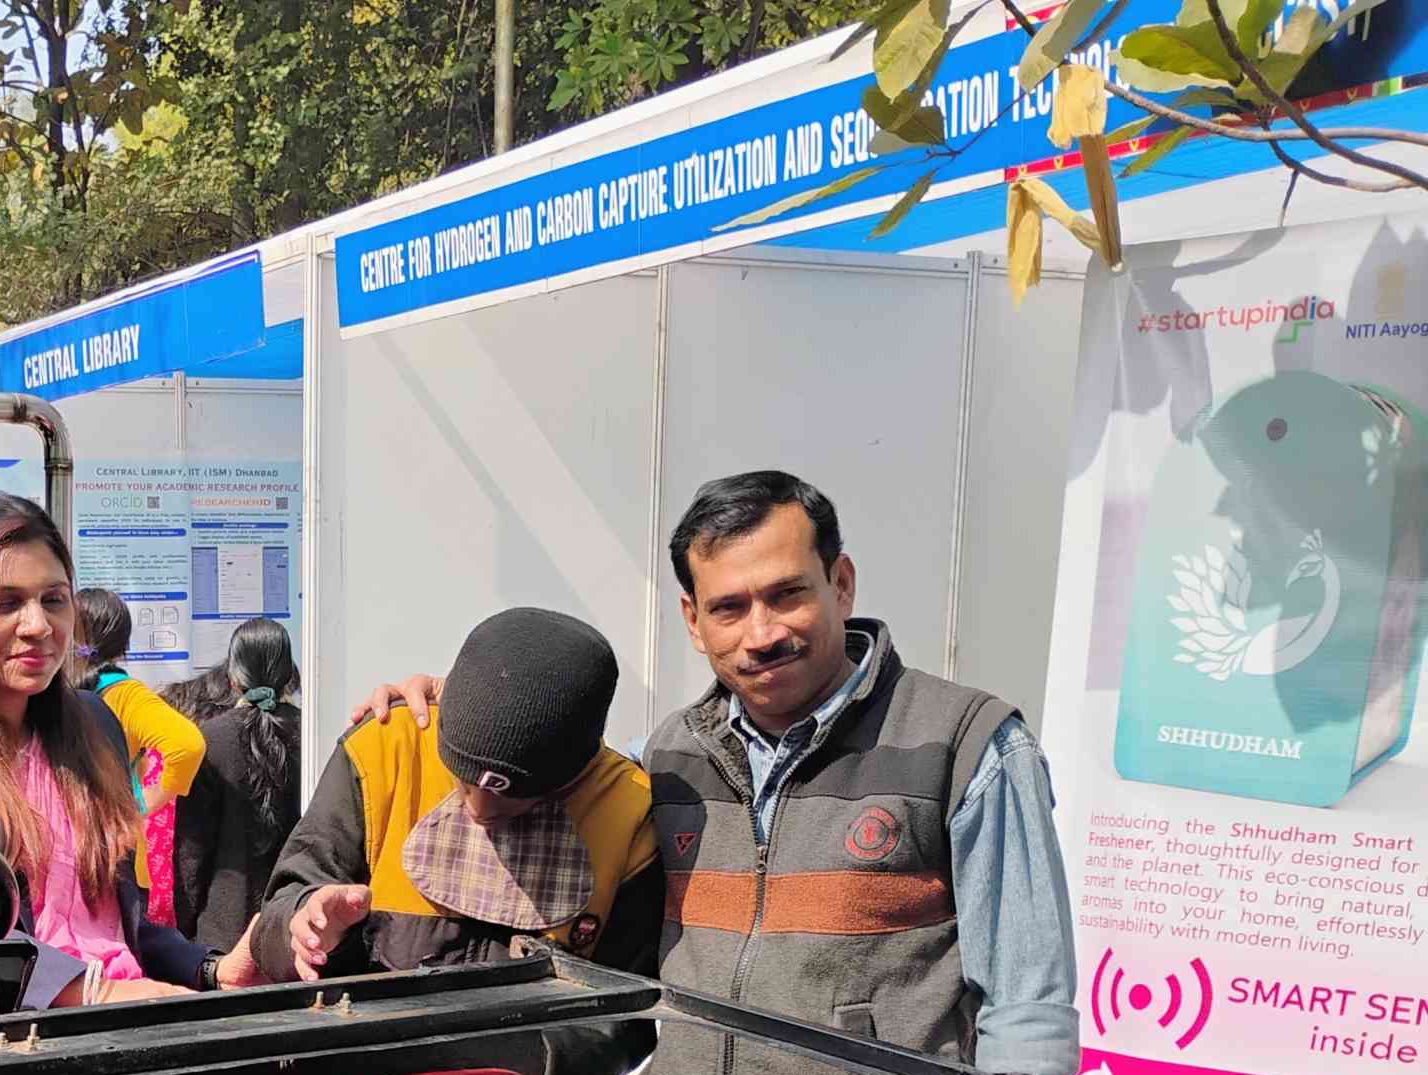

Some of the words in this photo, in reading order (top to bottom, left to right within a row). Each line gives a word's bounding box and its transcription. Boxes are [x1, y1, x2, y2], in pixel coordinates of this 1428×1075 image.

[360, 244, 405, 293] CENTRE
[408, 236, 432, 280] FOR
[435, 215, 501, 273] HYDROGEN
[505, 206, 532, 255] AND
[537, 187, 594, 246] CARBON
[598, 166, 668, 230] CAPTURE
[673, 134, 777, 209] UTILIZATION
[783, 121, 822, 181] AND
[1137, 296, 1334, 334] #startupindia
[1346, 322, 1376, 340] NITI
[24, 344, 78, 389] CENTRAL
[82, 324, 140, 374] LIBRARY
[1156, 725, 1303, 759] SHHUDHAM
[1090, 811, 1170, 835] Introducing
[1186, 818, 1216, 835] the
[1230, 822, 1337, 846] Shhudham
[1353, 832, 1414, 851] Smart
[1088, 832, 1156, 853] Freshener,
[1166, 838, 1283, 866] thoughtfully
[1291, 850, 1381, 872] designed
[1391, 856, 1421, 874] for
[1085, 853, 1108, 868] and
[1112, 854, 1133, 870] the
[1217, 863, 1253, 882] This
[1264, 870, 1405, 896] eco-conscious
[1083, 875, 1115, 889] smart
[1124, 877, 1224, 903] technology
[1239, 888, 1258, 903] to
[1274, 888, 1325, 914] bring
[1341, 899, 1415, 921] natural,
[1078, 913, 1165, 939] sustainability
[1170, 924, 1210, 941] with
[1217, 930, 1292, 949] modern
[1298, 935, 1355, 960] living.
[1081, 894, 1124, 910] aromas
[1133, 896, 1167, 914] into
[1181, 905, 1225, 921] your
[1240, 908, 1300, 930] home,
[1316, 916, 1424, 946] effortlessly
[1228, 977, 1356, 1016] SMART
[1309, 1026, 1418, 1064] inside
